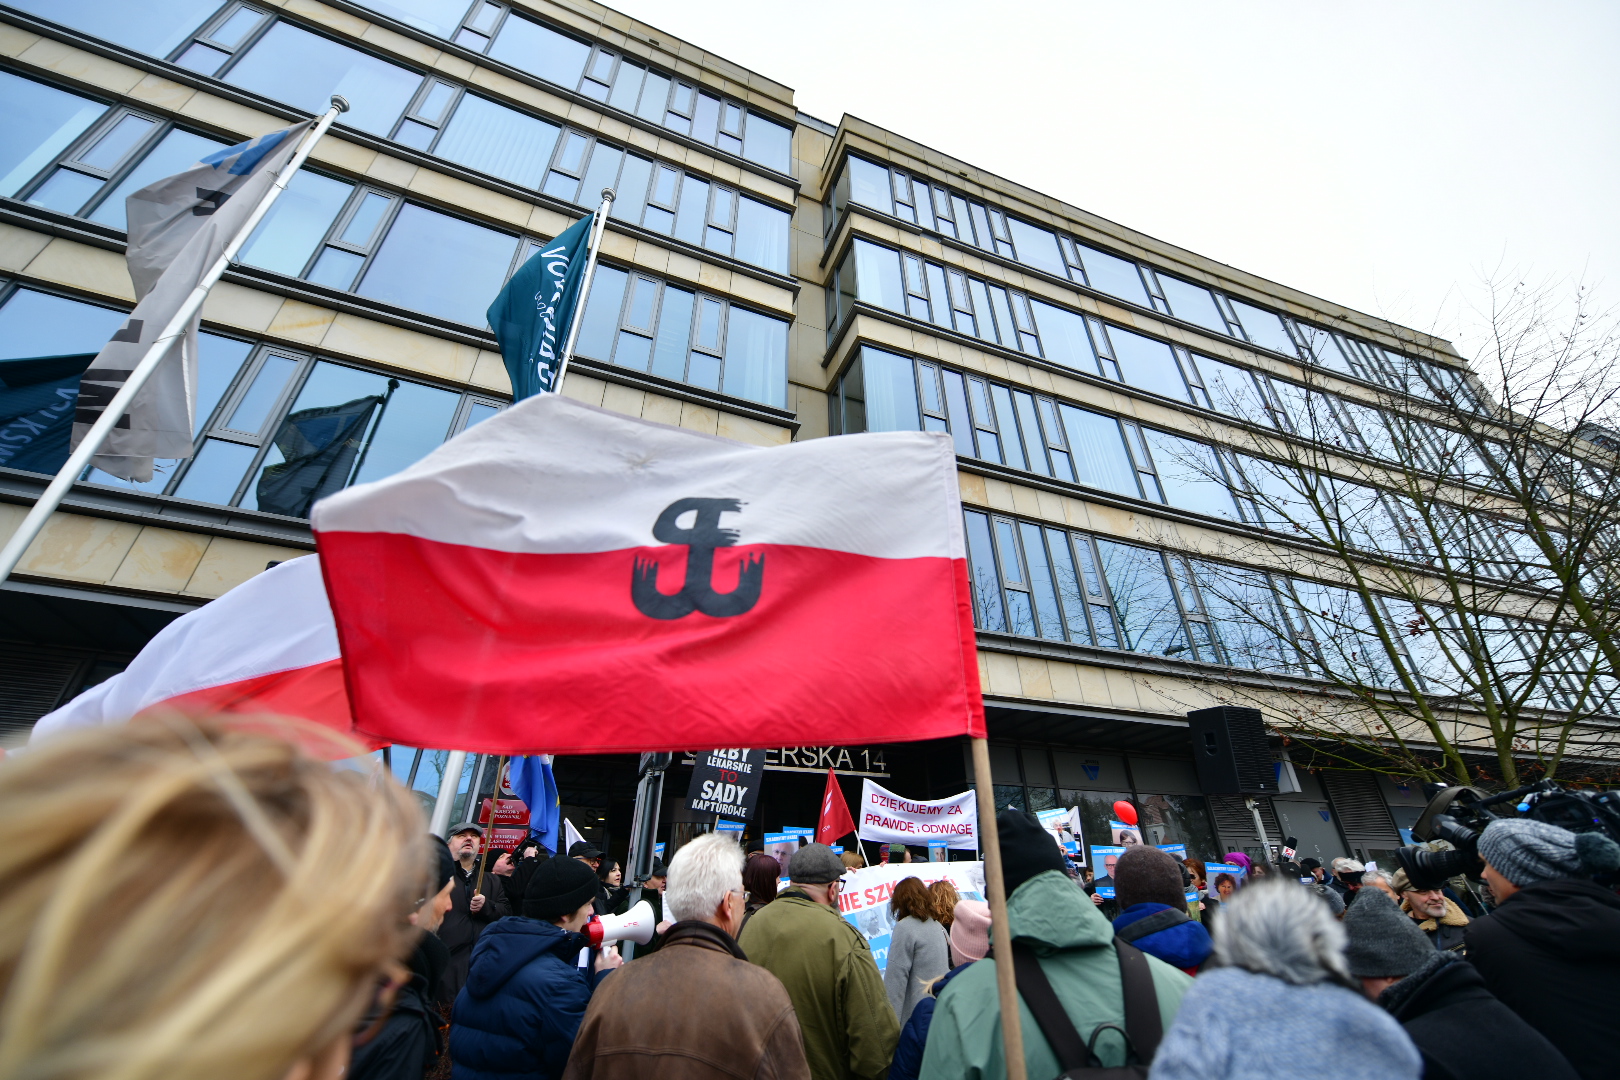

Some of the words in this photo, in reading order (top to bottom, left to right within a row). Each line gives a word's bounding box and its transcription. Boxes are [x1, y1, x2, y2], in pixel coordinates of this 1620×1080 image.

[706, 756, 753, 774] LEKARSKIE
[718, 769, 739, 783] TO
[871, 793, 944, 815] DZIĘKUJEMY
[947, 804, 963, 815] ZA
[865, 813, 915, 834] PRAWDĘ
[921, 823, 973, 837] ODWAGĘ
